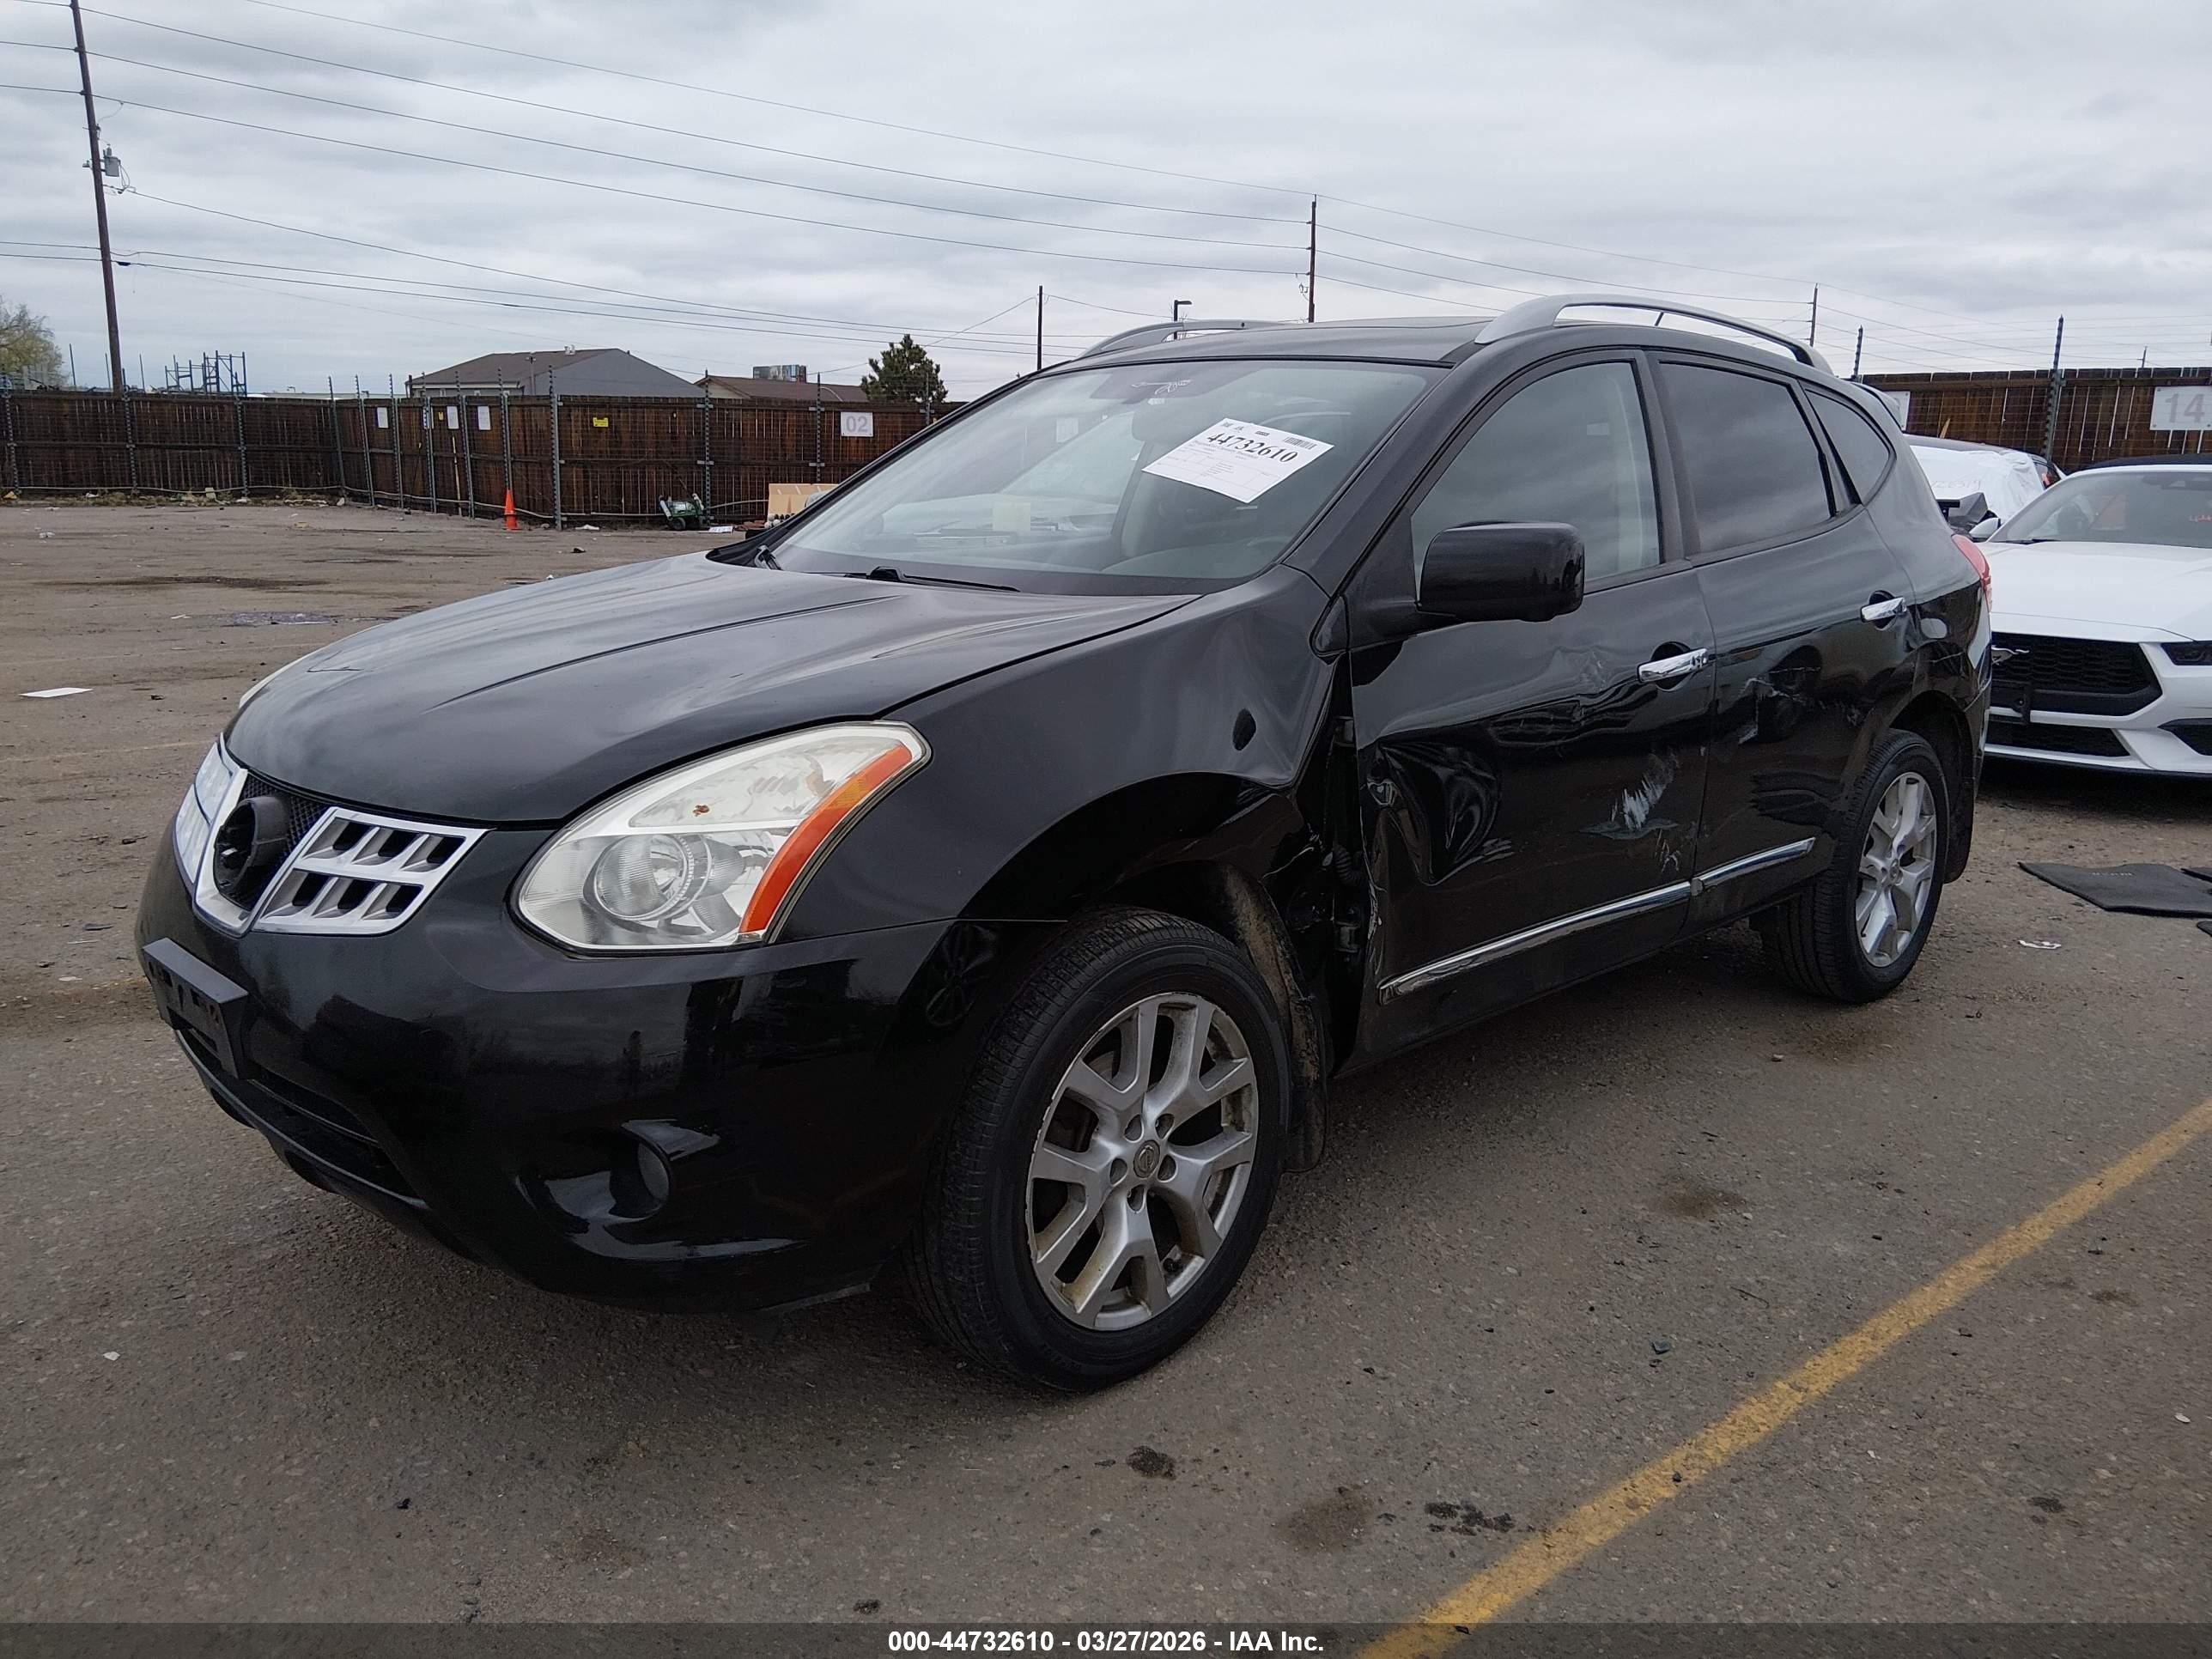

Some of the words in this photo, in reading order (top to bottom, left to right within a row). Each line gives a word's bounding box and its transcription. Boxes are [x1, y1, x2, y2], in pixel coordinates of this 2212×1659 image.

[2166, 393, 2205, 423] 14
[846, 416, 868, 433] 02
[1207, 432, 1298, 463] 44732610
